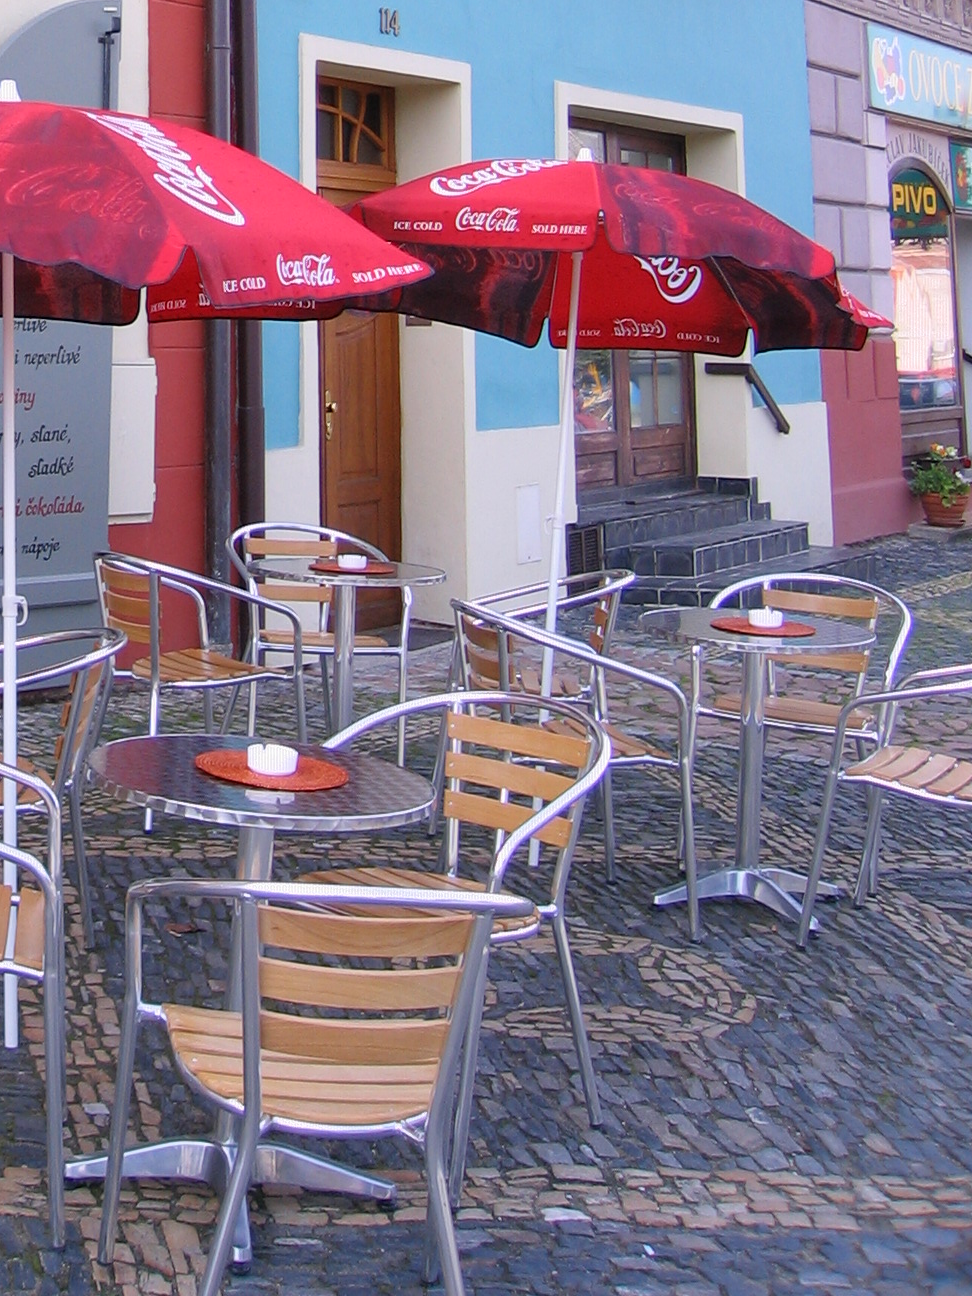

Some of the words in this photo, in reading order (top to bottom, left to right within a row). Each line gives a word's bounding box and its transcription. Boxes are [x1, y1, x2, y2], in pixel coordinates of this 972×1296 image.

[379, 7, 400, 37] 114
[908, 50, 964, 113] OVOCE
[892, 183, 938, 216] PIVO
[394, 220, 412, 231] ICE
[414, 221, 443, 232] COLD
[531, 224, 559, 235] SOLD
[559, 224, 588, 235] HERE
[223, 280, 239, 293] ICE
[240, 276, 267, 292] COLD
[351, 267, 387, 285] SOLD
[388, 262, 425, 278] HERE
[24, 344, 81, 371] neperlivé
[30, 423, 71, 445] slané,
[28, 456, 74, 478] sladké
[25, 494, 85, 517] čokoláda
[21, 536, 61, 561] nápoje
